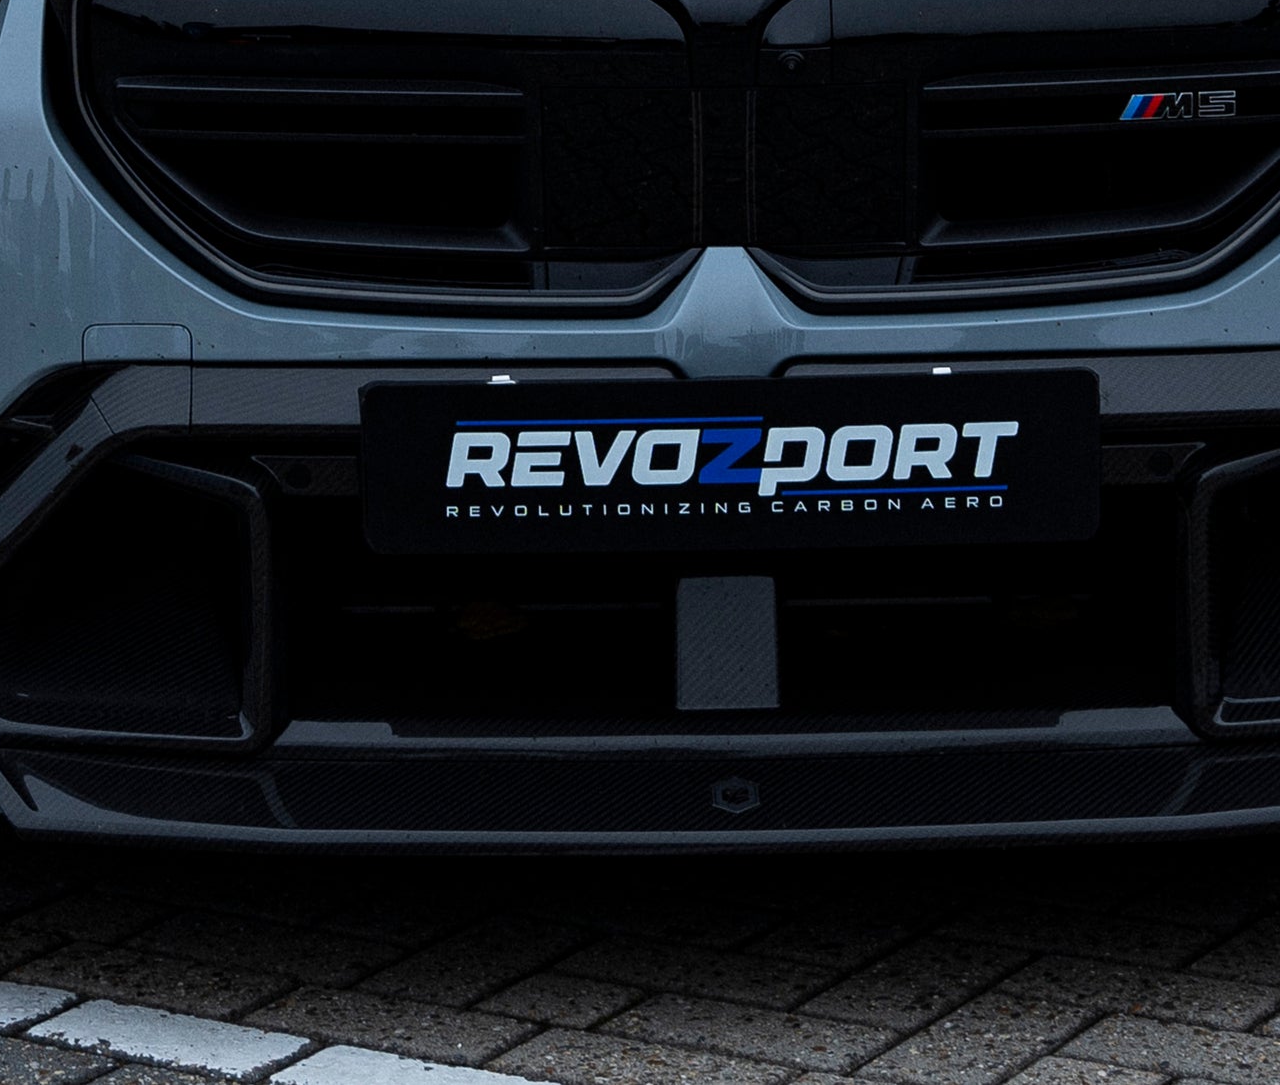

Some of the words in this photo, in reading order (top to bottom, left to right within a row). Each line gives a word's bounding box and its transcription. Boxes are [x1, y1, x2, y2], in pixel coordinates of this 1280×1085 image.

[1148, 90, 1236, 120] M5
[446, 421, 1020, 498] REVOZPORT
[446, 500, 753, 518] REVOLUTIONIZING
[771, 496, 902, 514] CARBON
[920, 493, 1005, 510] AERO
